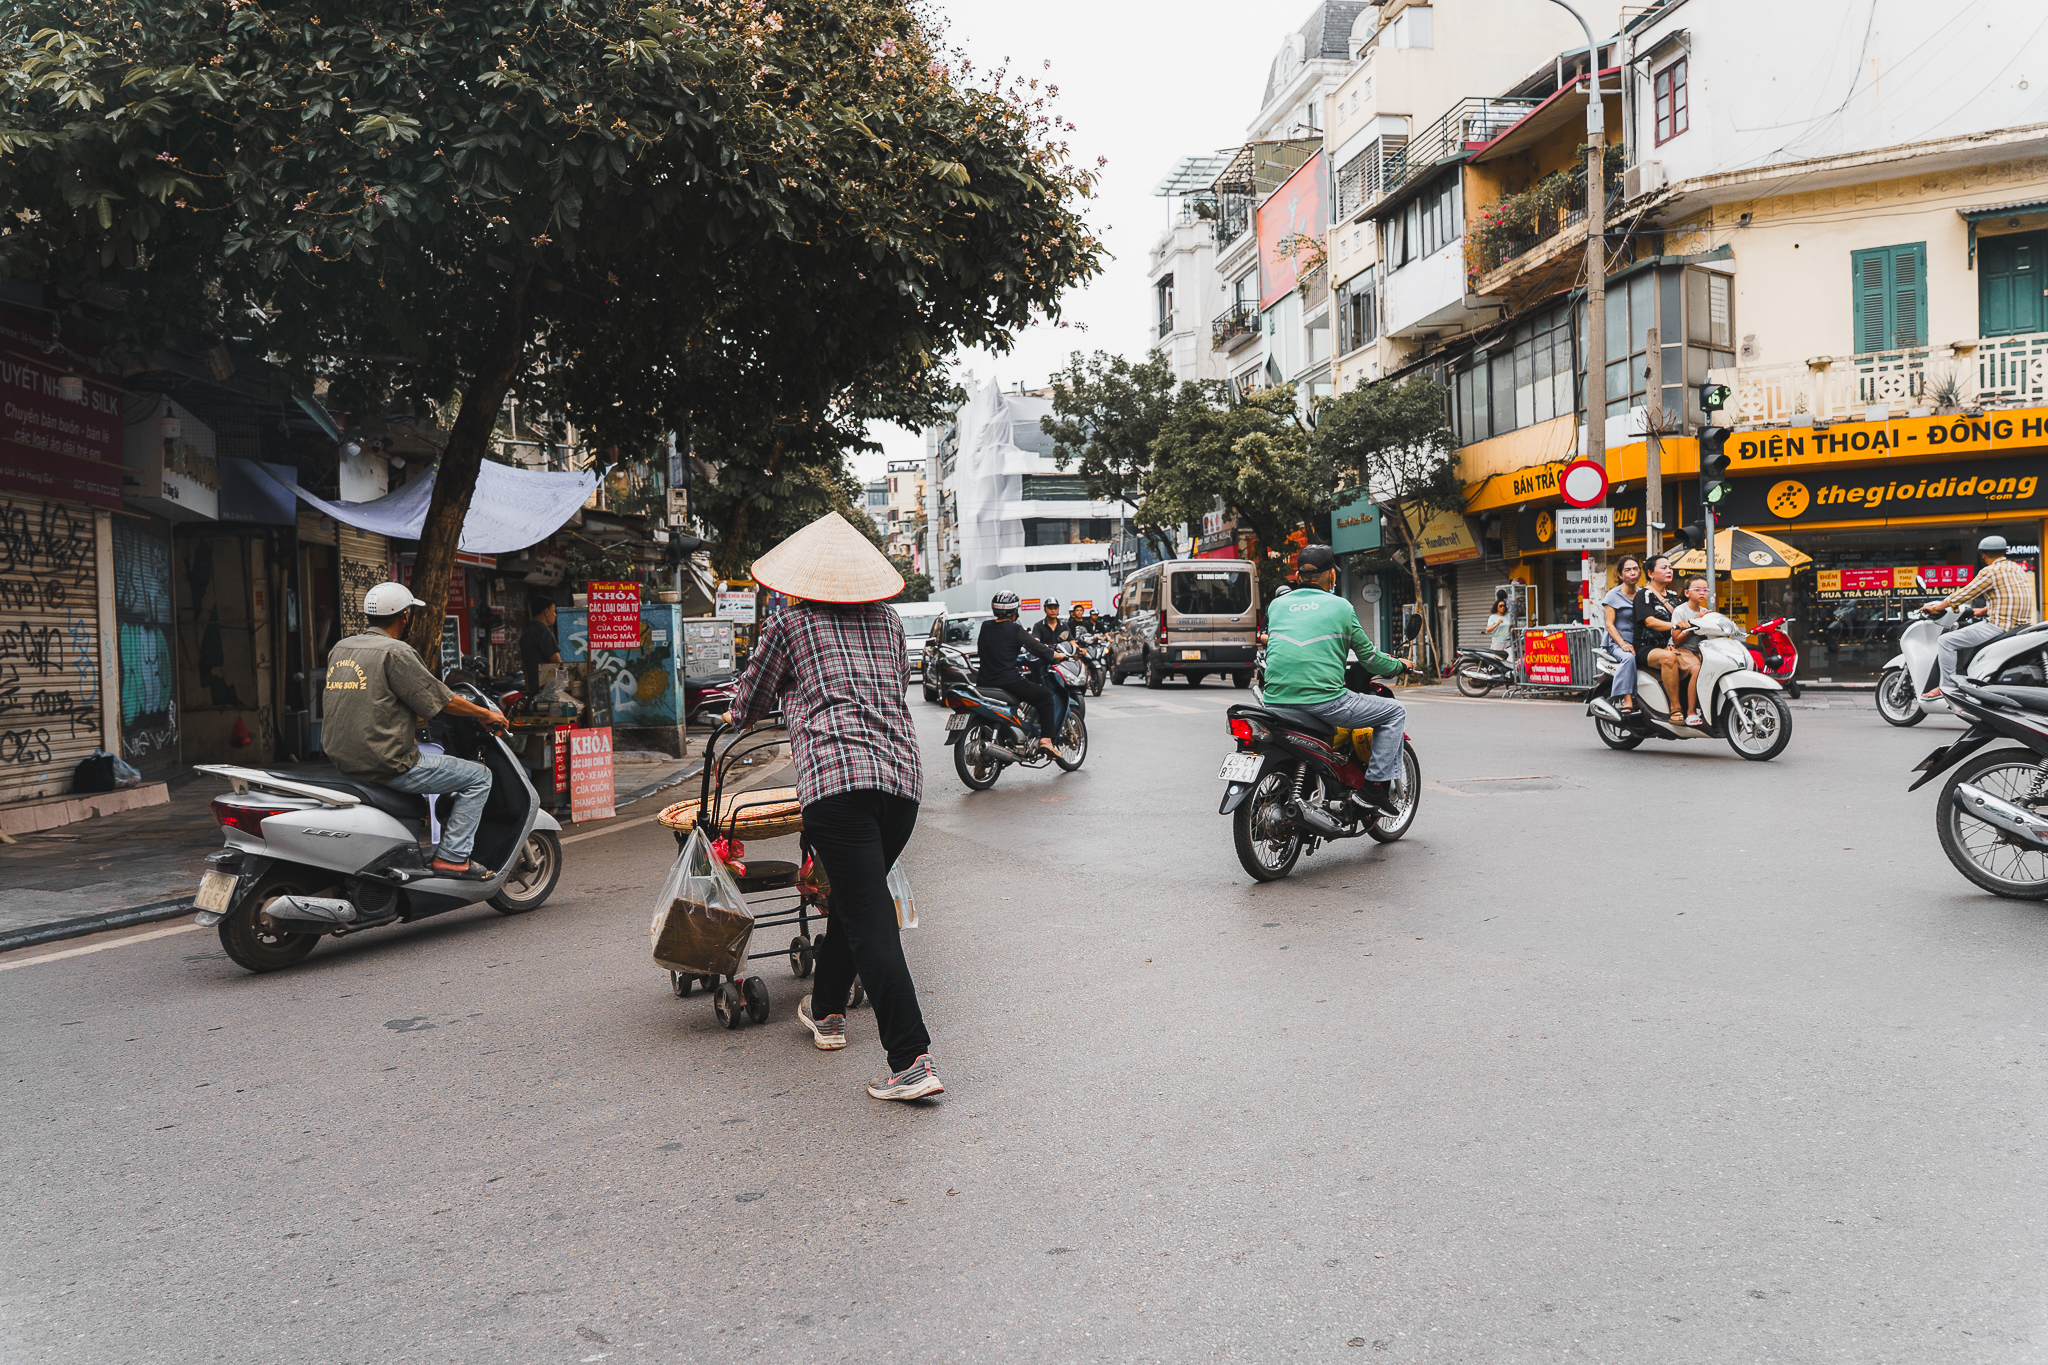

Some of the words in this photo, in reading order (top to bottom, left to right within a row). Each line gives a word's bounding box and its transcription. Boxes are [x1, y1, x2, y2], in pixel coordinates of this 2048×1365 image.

[0, 360, 39, 391] UYẾT
[92, 391, 118, 416] SILK
[5, 402, 39, 425] Chuyên
[41, 412, 57, 429] bán
[59, 417, 79, 435] buôn
[86, 424, 100, 441] bán
[15, 428, 30, 443] các
[50, 435, 60, 450] áo
[63, 439, 76, 454] dài
[89, 449, 101, 460] em
[1739, 435, 1804, 463] ĐIỆN
[1812, 428, 1899, 454] THOẠI
[1927, 414, 2013, 445] ĐỒNG
[1513, 473, 1534, 496] BÁN
[1535, 467, 1555, 491] TRẢ
[1816, 476, 2038, 508] thegioididong
[1562, 514, 1580, 525] TUYẾN
[1580, 513, 1591, 524] PHỐ
[1600, 514, 1608, 525] BỘ
[592, 590, 637, 600] KHÓA
[1821, 591, 1841, 599] MUA
[1843, 589, 1862, 598] TRẢ
[1864, 588, 1891, 598] CHẬM
[1897, 588, 1918, 596] MUA
[589, 601, 601, 612] CÁC
[602, 603, 616, 614] LOẠI
[1288, 601, 1319, 612] Grab
[597, 623, 612, 631] CỬA
[612, 623, 633, 631] CUỐN
[620, 631, 637, 640] MÁY
[1560, 654, 1570, 664] XE
[326, 681, 343, 691] LẠNG
[344, 681, 359, 690] SƠN
[572, 730, 612, 756] KHÓA
[1227, 756, 1257, 767] 29-C1
[589, 771, 596, 780] XE
[597, 767, 612, 778] MÁY
[1220, 766, 1255, 781] 837.41
[576, 783, 589, 794] CỬA
[590, 780, 610, 792] CUỐN
[574, 797, 596, 807] THANG
[597, 795, 611, 805] MÁY
